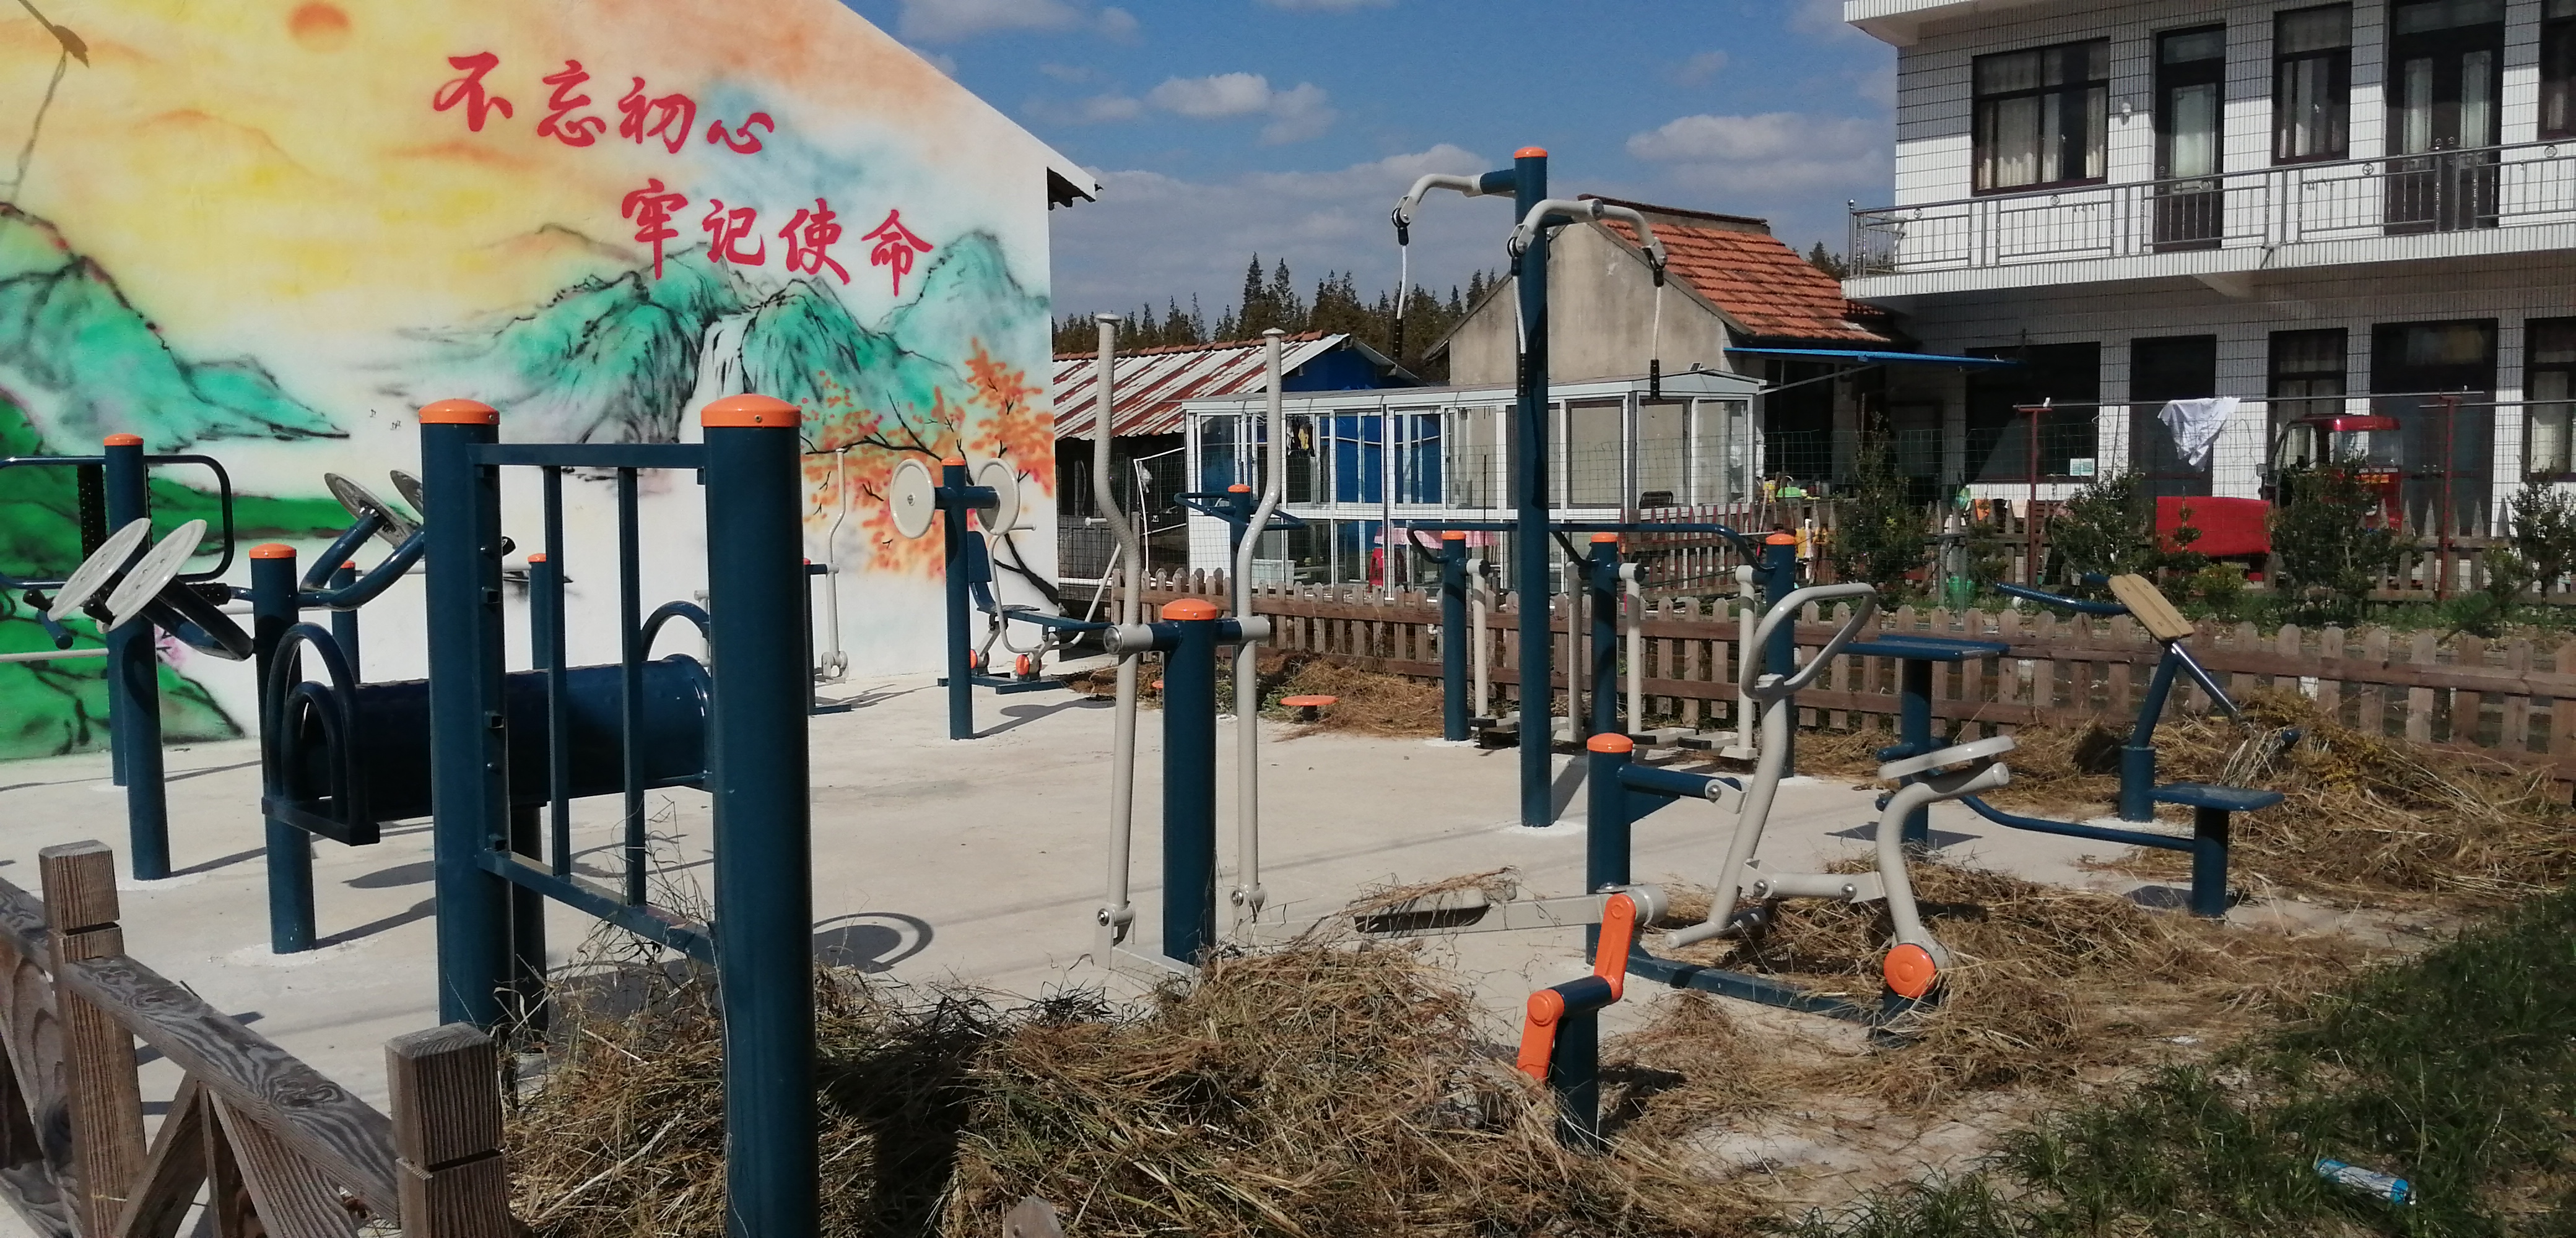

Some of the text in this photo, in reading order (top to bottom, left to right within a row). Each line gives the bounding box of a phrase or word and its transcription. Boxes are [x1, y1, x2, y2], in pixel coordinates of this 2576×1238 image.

[432, 51, 775, 155] 不忘初心
[621, 178, 934, 297] 牢记使命
